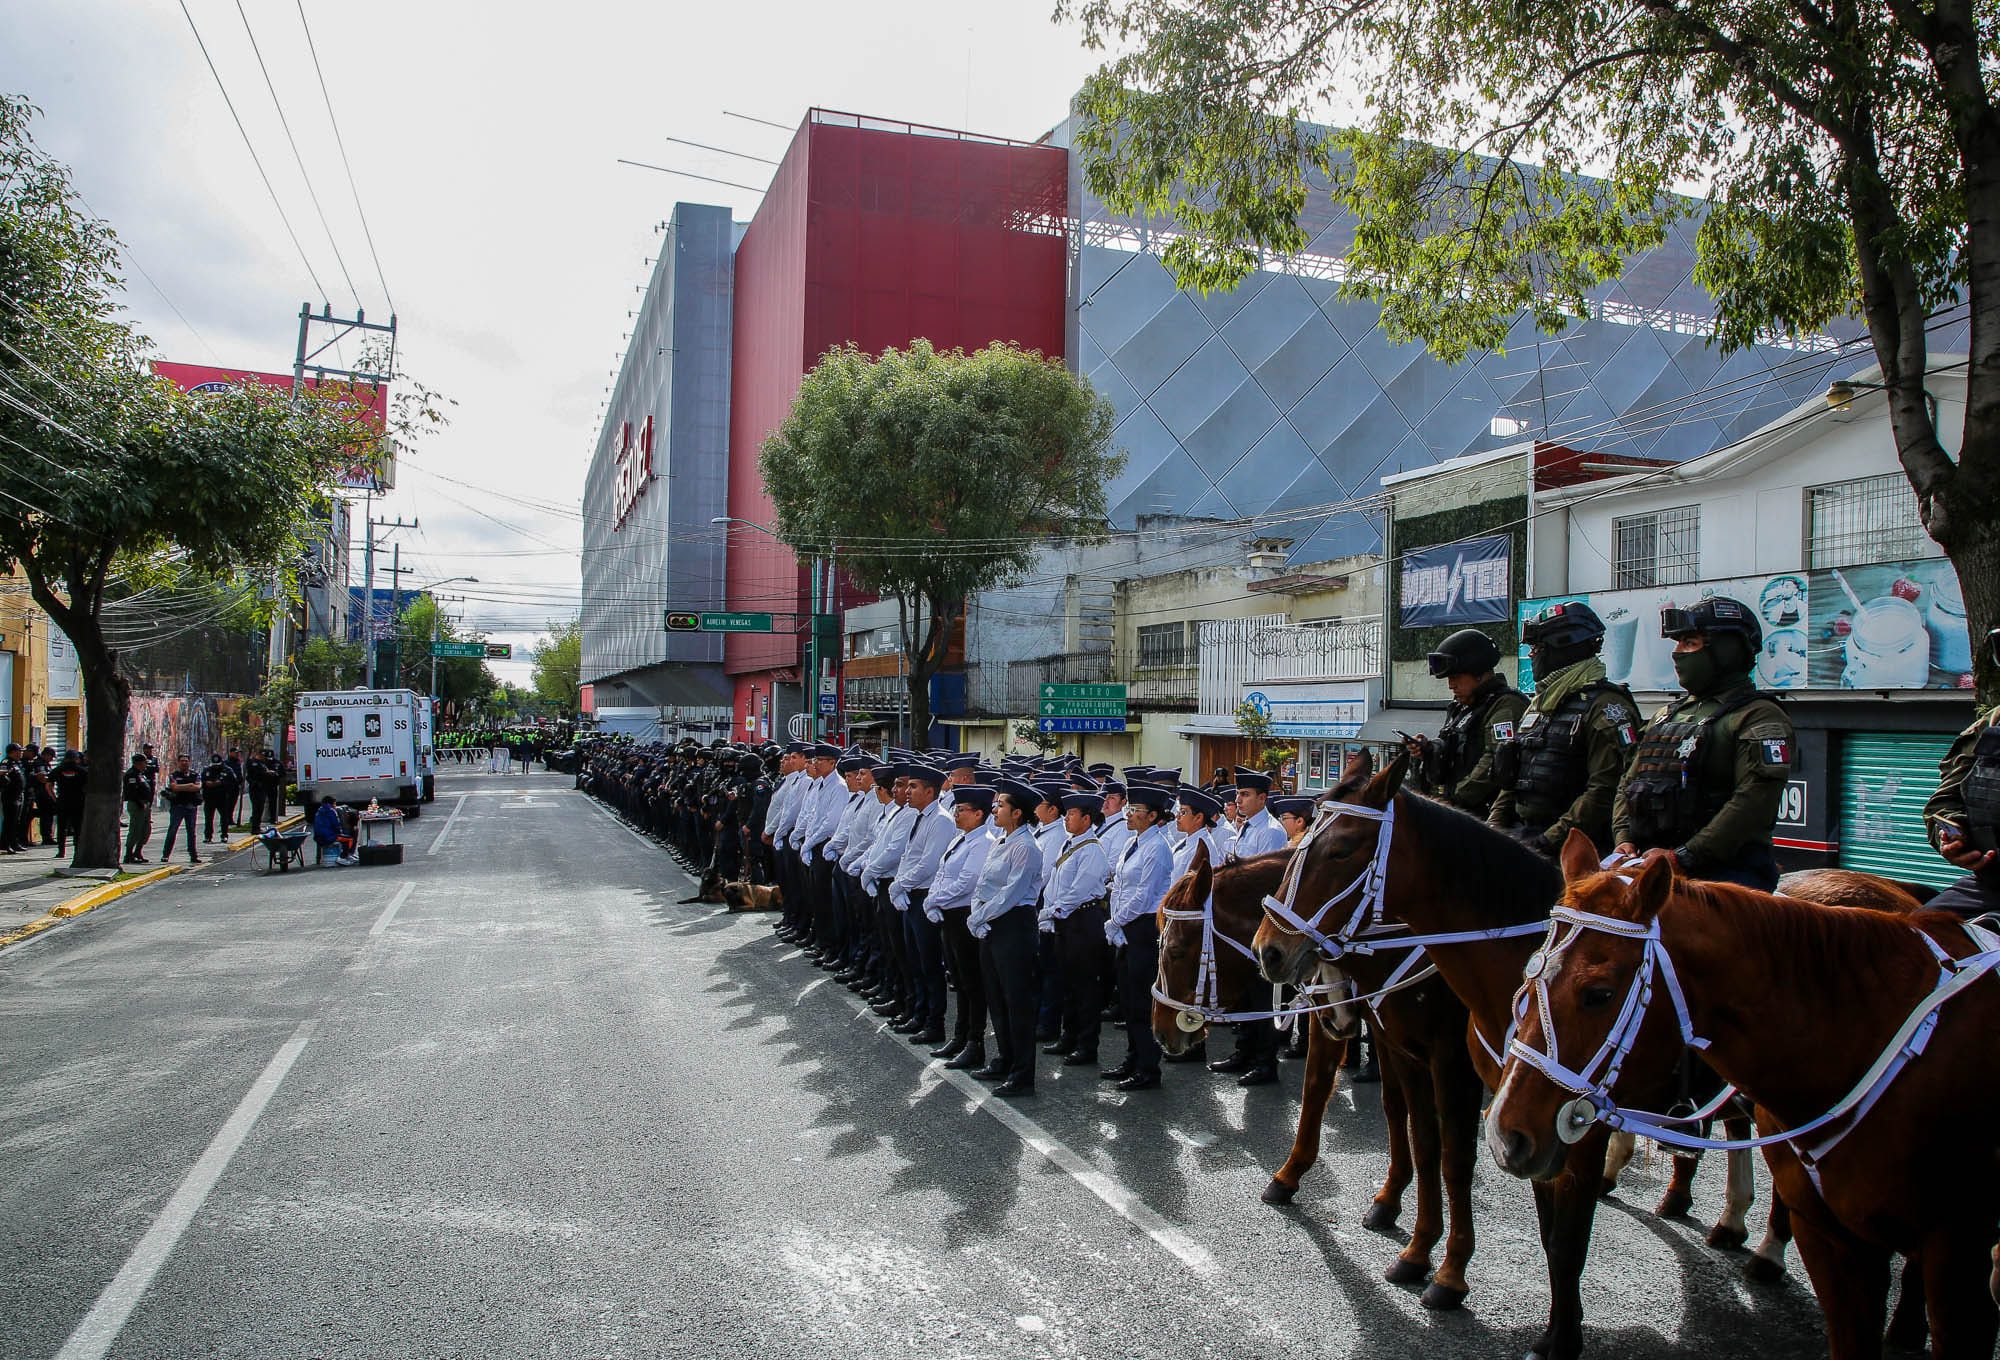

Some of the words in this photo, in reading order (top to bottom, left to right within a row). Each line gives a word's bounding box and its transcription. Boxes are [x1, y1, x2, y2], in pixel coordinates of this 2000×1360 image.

[706, 618, 726, 626] AURELIO
[300, 722, 313, 733] SS
[394, 720, 408, 730] SS
[1062, 720, 1112, 730] ALAMEDA
[362, 746, 393, 756] ESTATAL
